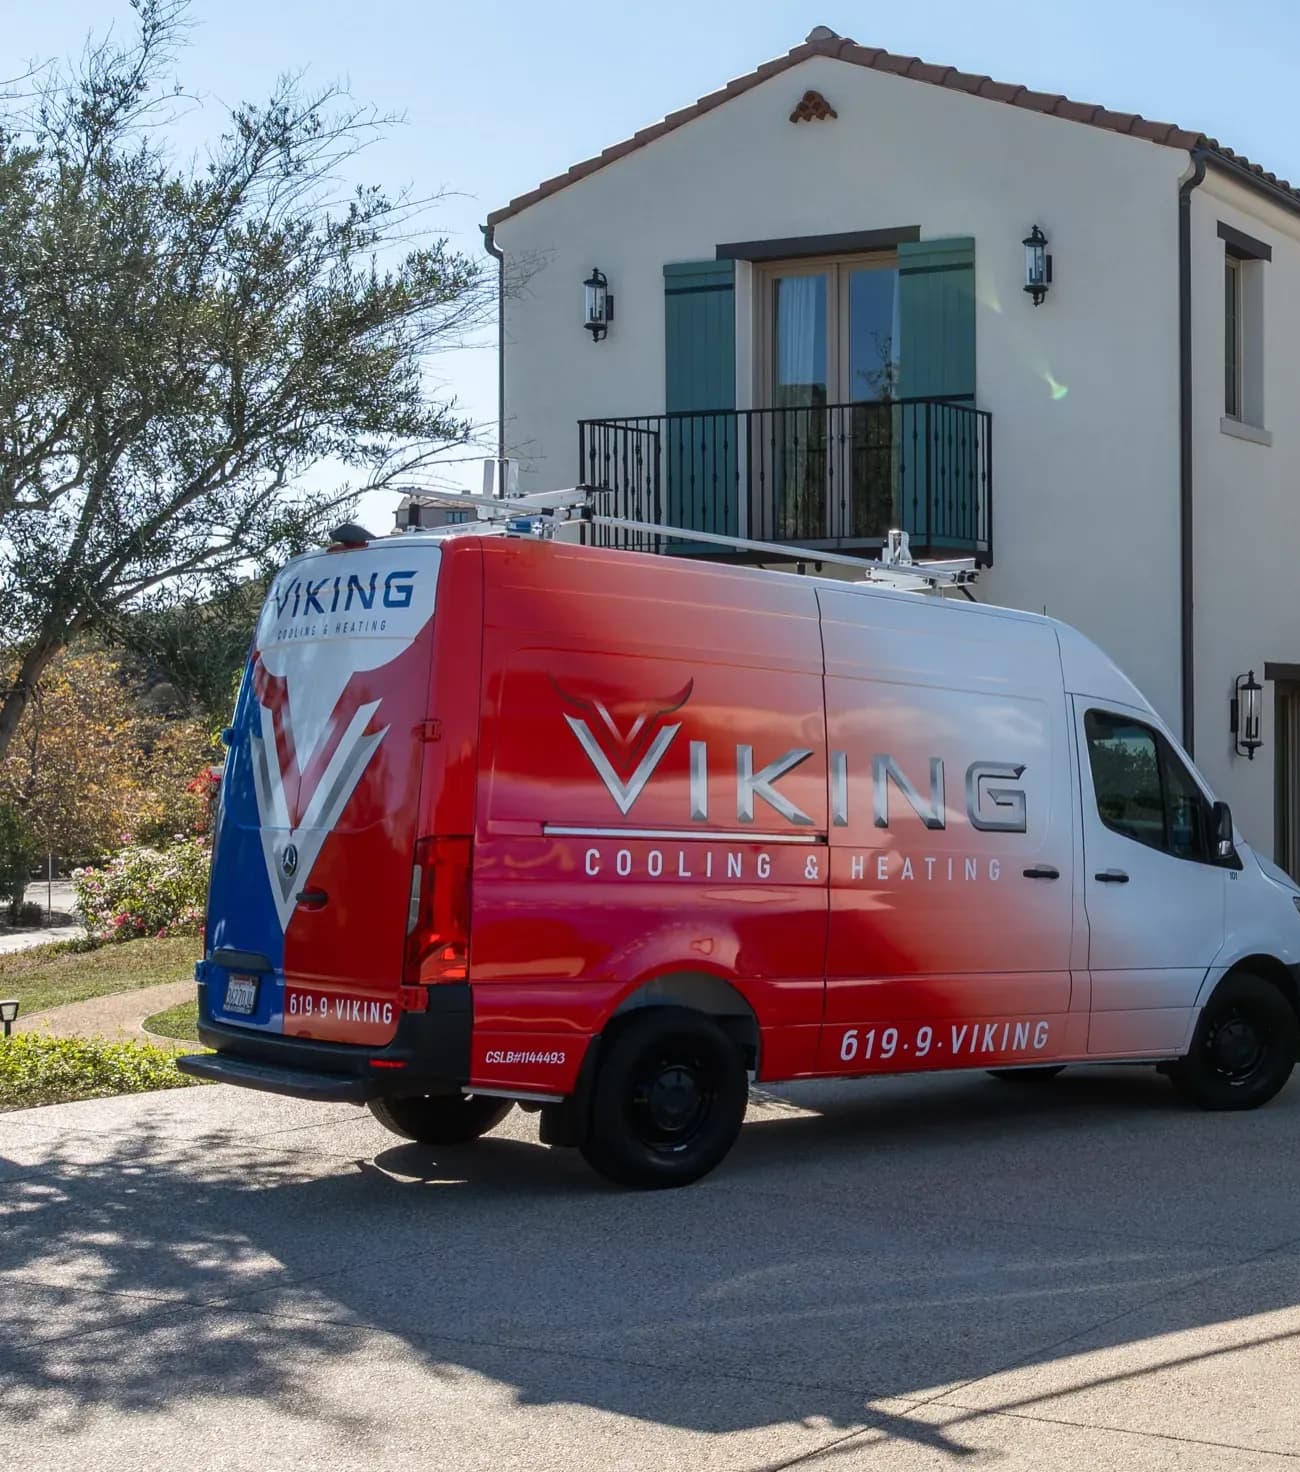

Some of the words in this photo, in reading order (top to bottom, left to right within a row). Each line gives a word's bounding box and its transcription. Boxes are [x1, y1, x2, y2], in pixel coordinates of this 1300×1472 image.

[275, 571, 419, 620] VIKING
[277, 625, 316, 640] COOLING
[322, 626, 328, 635] &
[335, 620, 387, 633] HEATING
[562, 712, 1028, 834] VIKING
[585, 848, 771, 878] COOLING
[804, 855, 819, 879] &
[851, 855, 1001, 880] HEATING
[485, 1051, 566, 1064] CSLB#1144493
